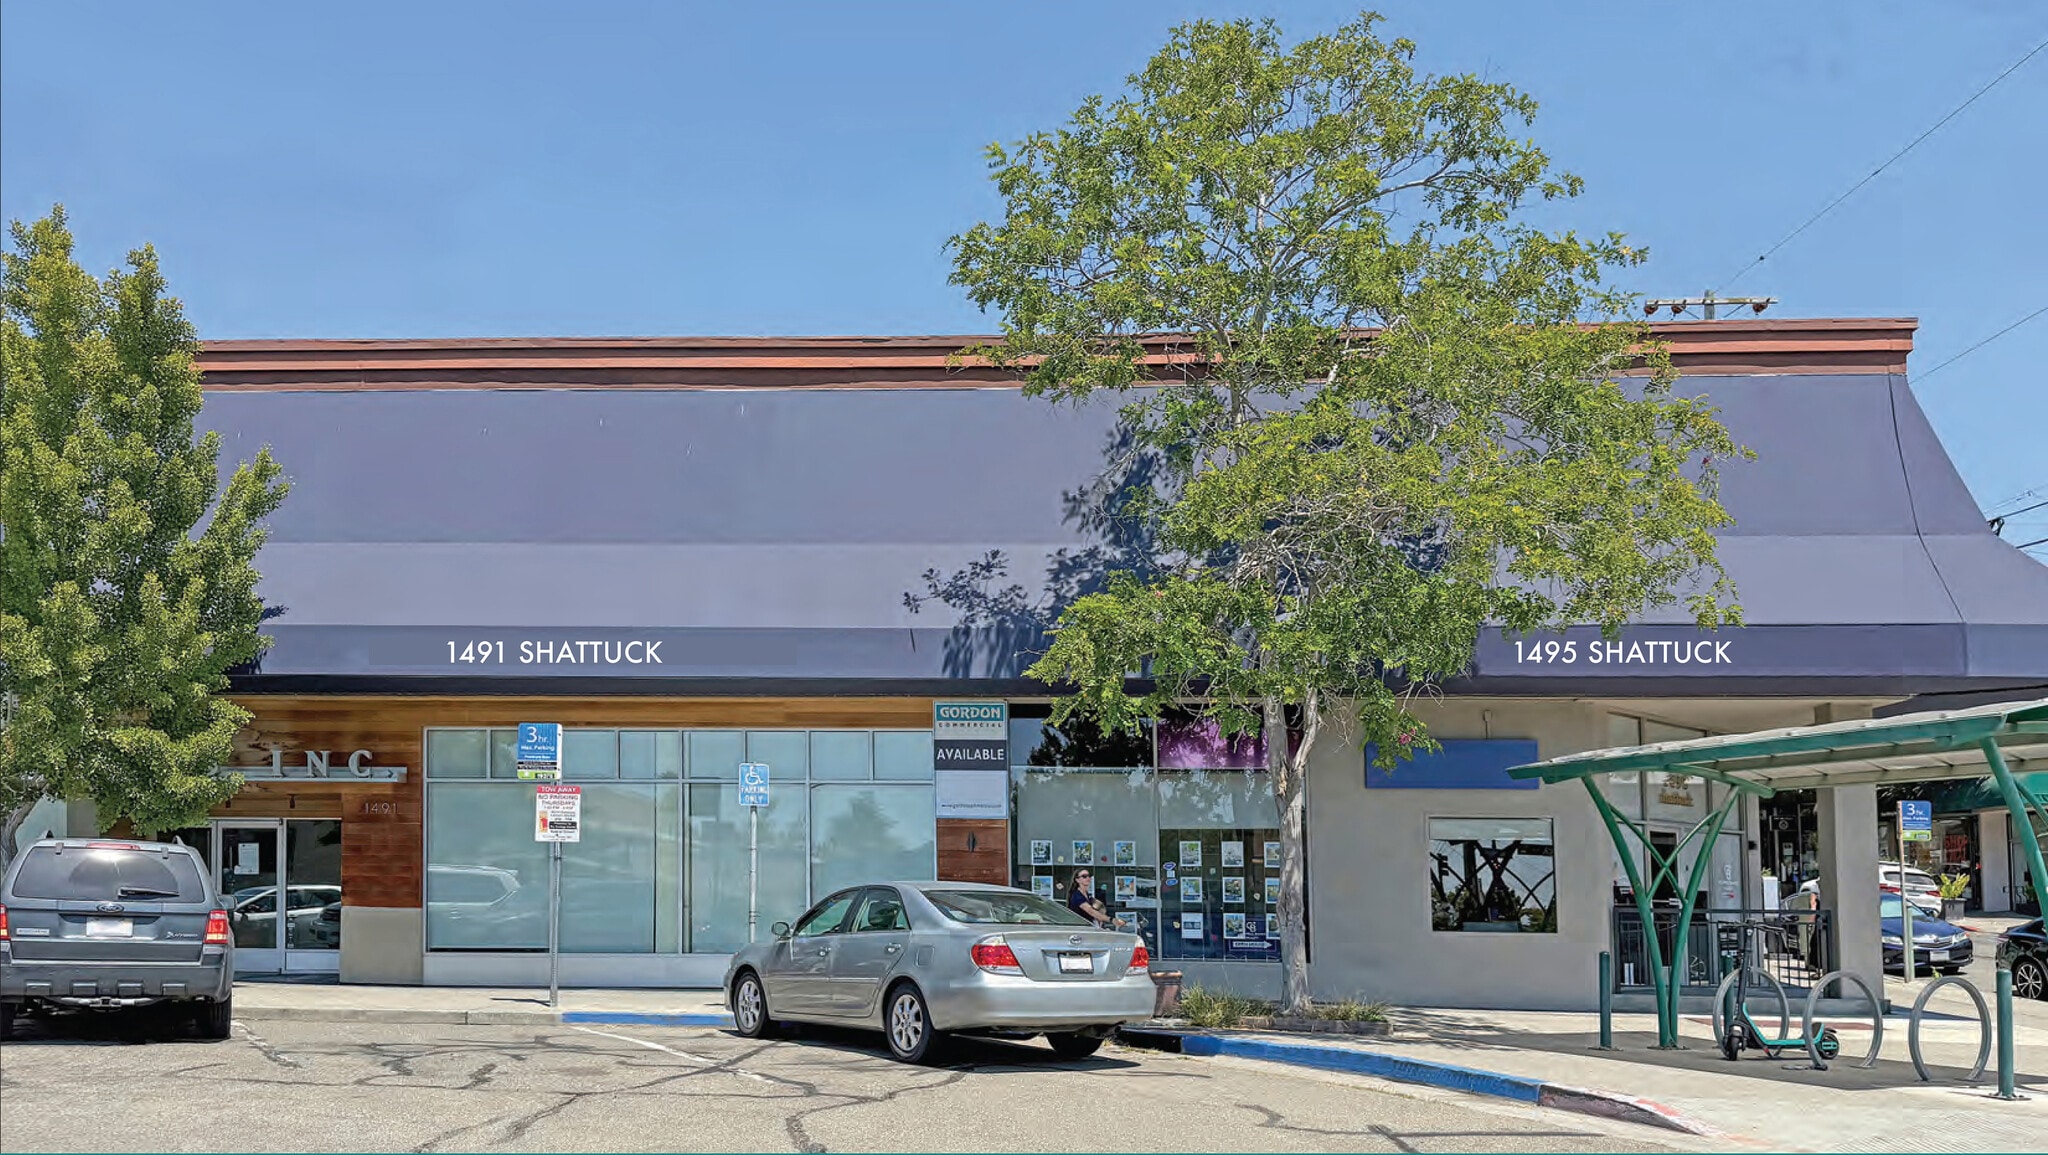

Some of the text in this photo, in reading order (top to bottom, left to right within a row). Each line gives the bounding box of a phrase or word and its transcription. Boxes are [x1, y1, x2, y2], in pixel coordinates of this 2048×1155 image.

[940, 706, 1001, 719] GORDON
[526, 726, 537, 743] 3
[936, 748, 1005, 761] AVAILABLE
[364, 802, 398, 815] 1491
[1907, 803, 1915, 816] 3
